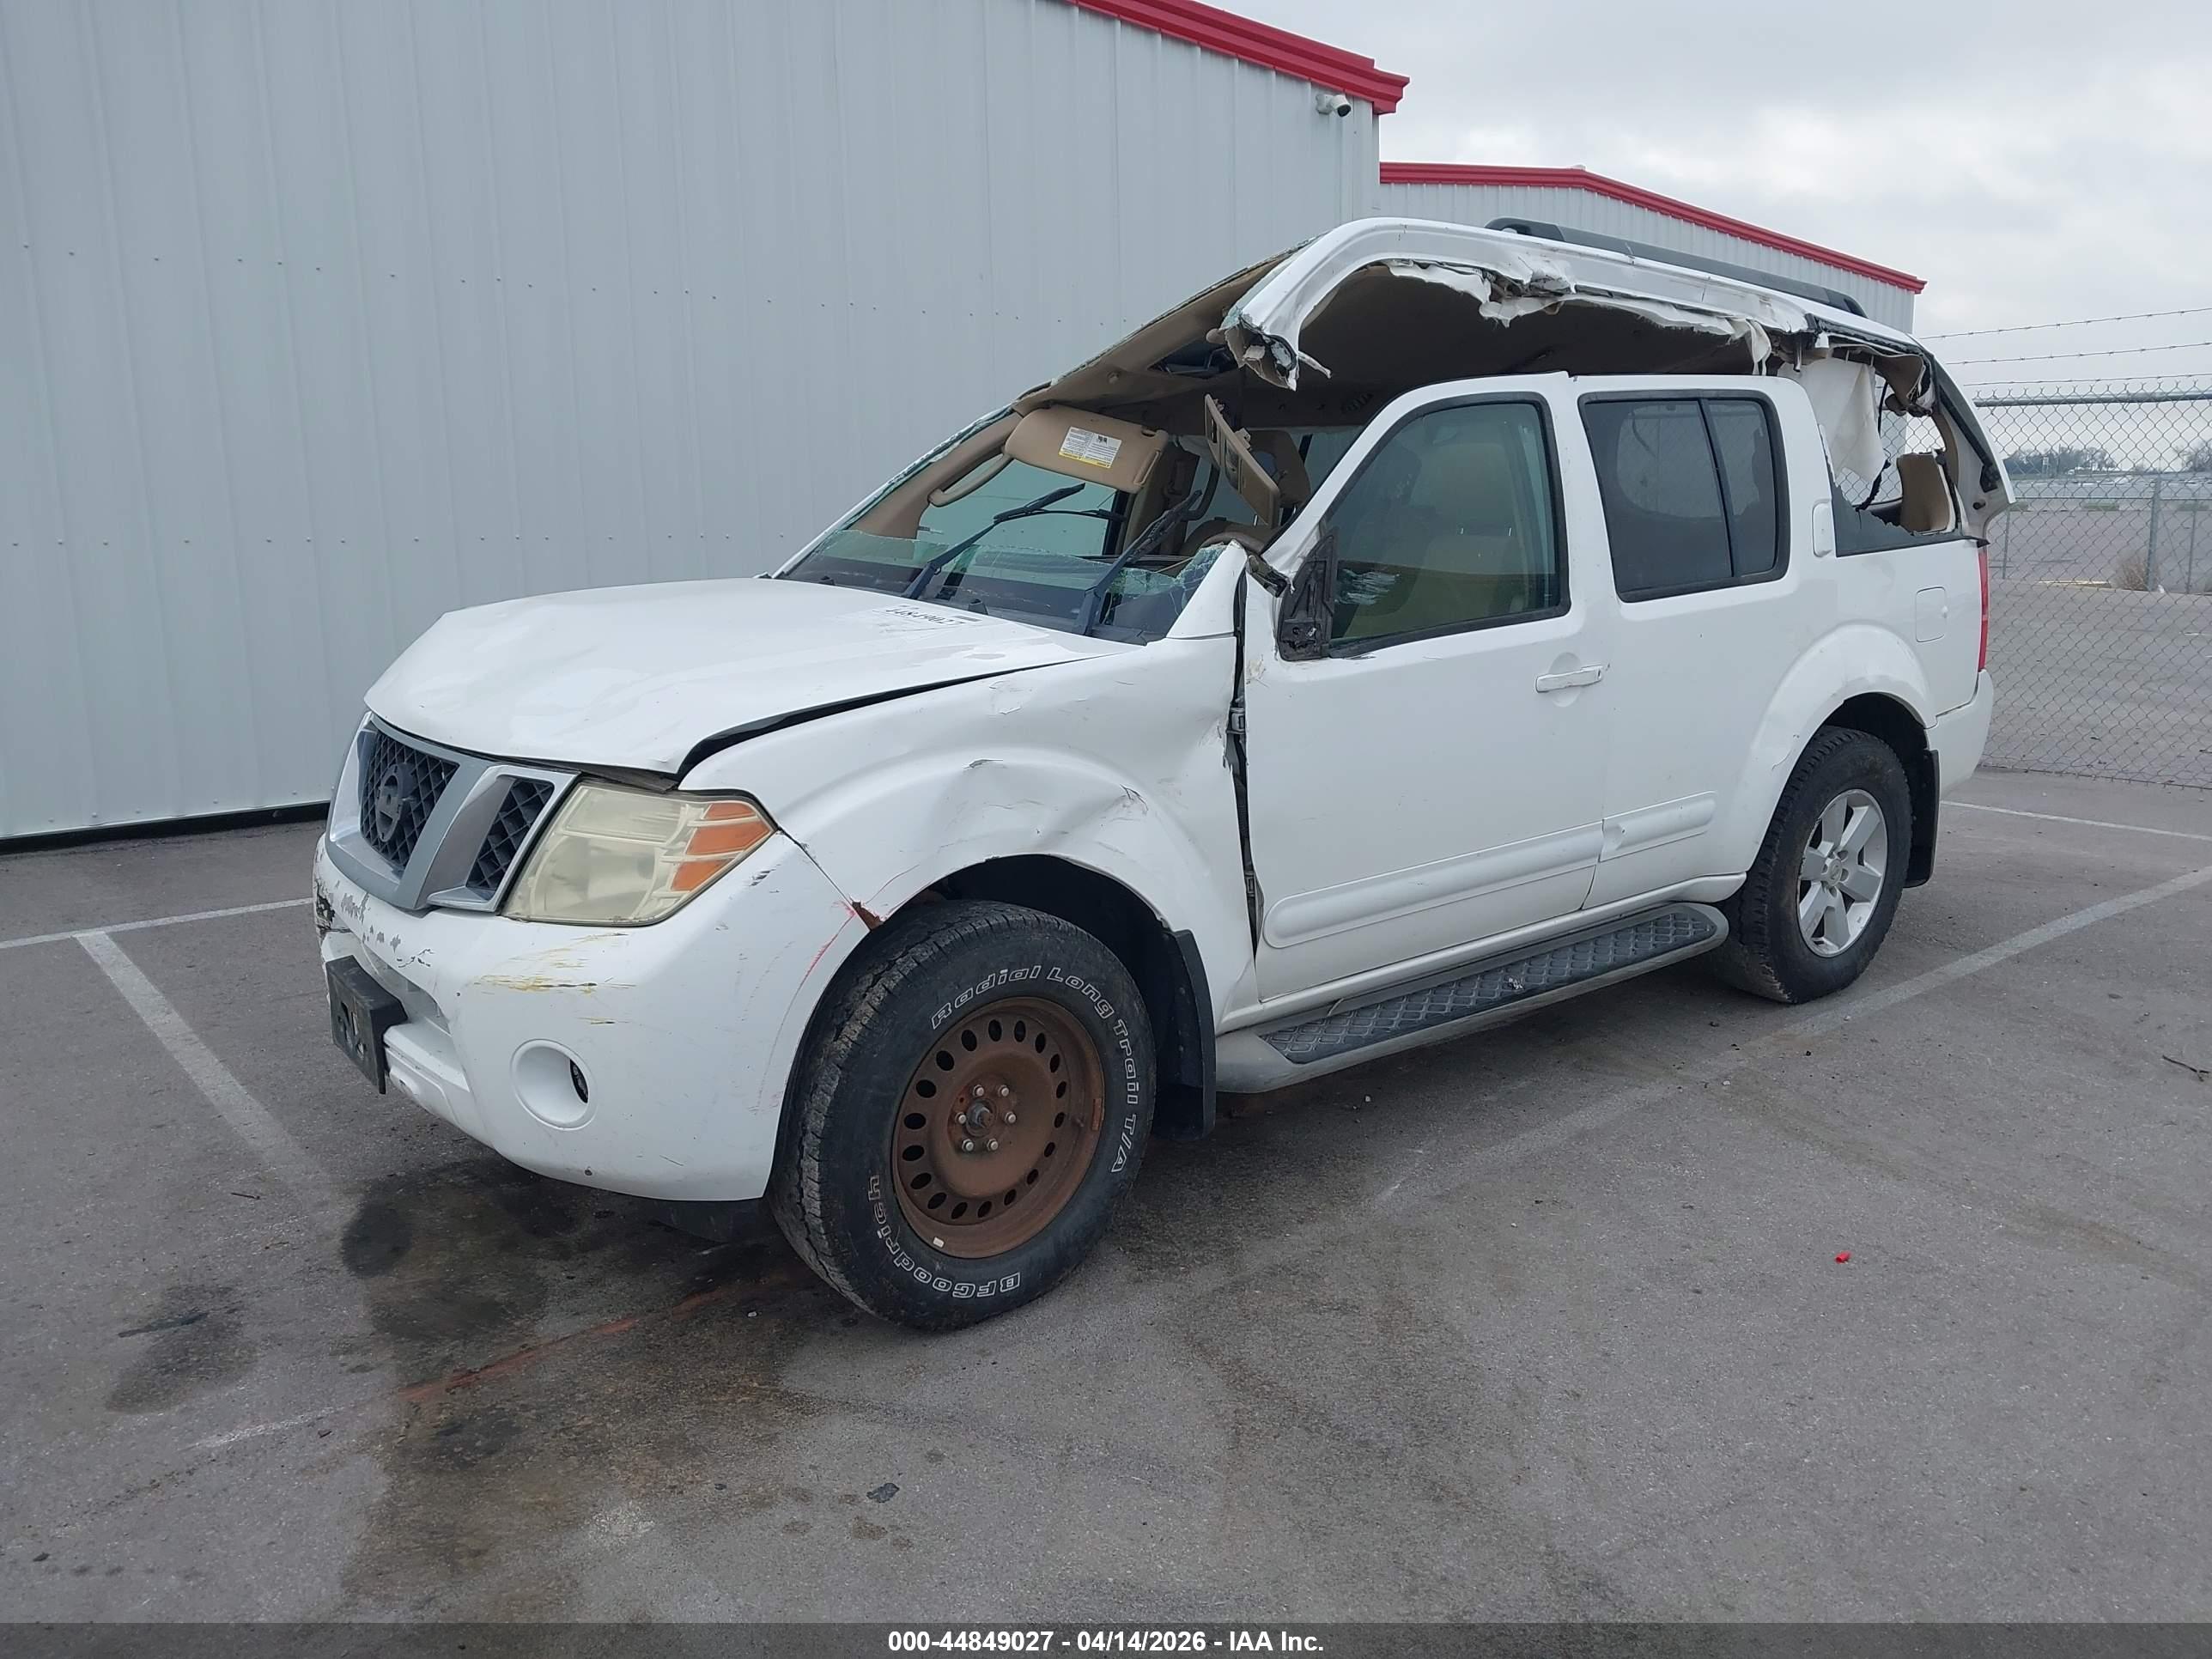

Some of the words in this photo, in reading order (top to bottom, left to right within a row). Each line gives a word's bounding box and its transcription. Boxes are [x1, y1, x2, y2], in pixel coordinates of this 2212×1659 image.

[931, 965, 1042, 1030] Radial
[1046, 967, 1115, 1018] Long
[1113, 1019, 1139, 1104] Trail
[1111, 1114, 1137, 1173] T/A
[868, 1175, 1021, 1298] BFGoodrich
